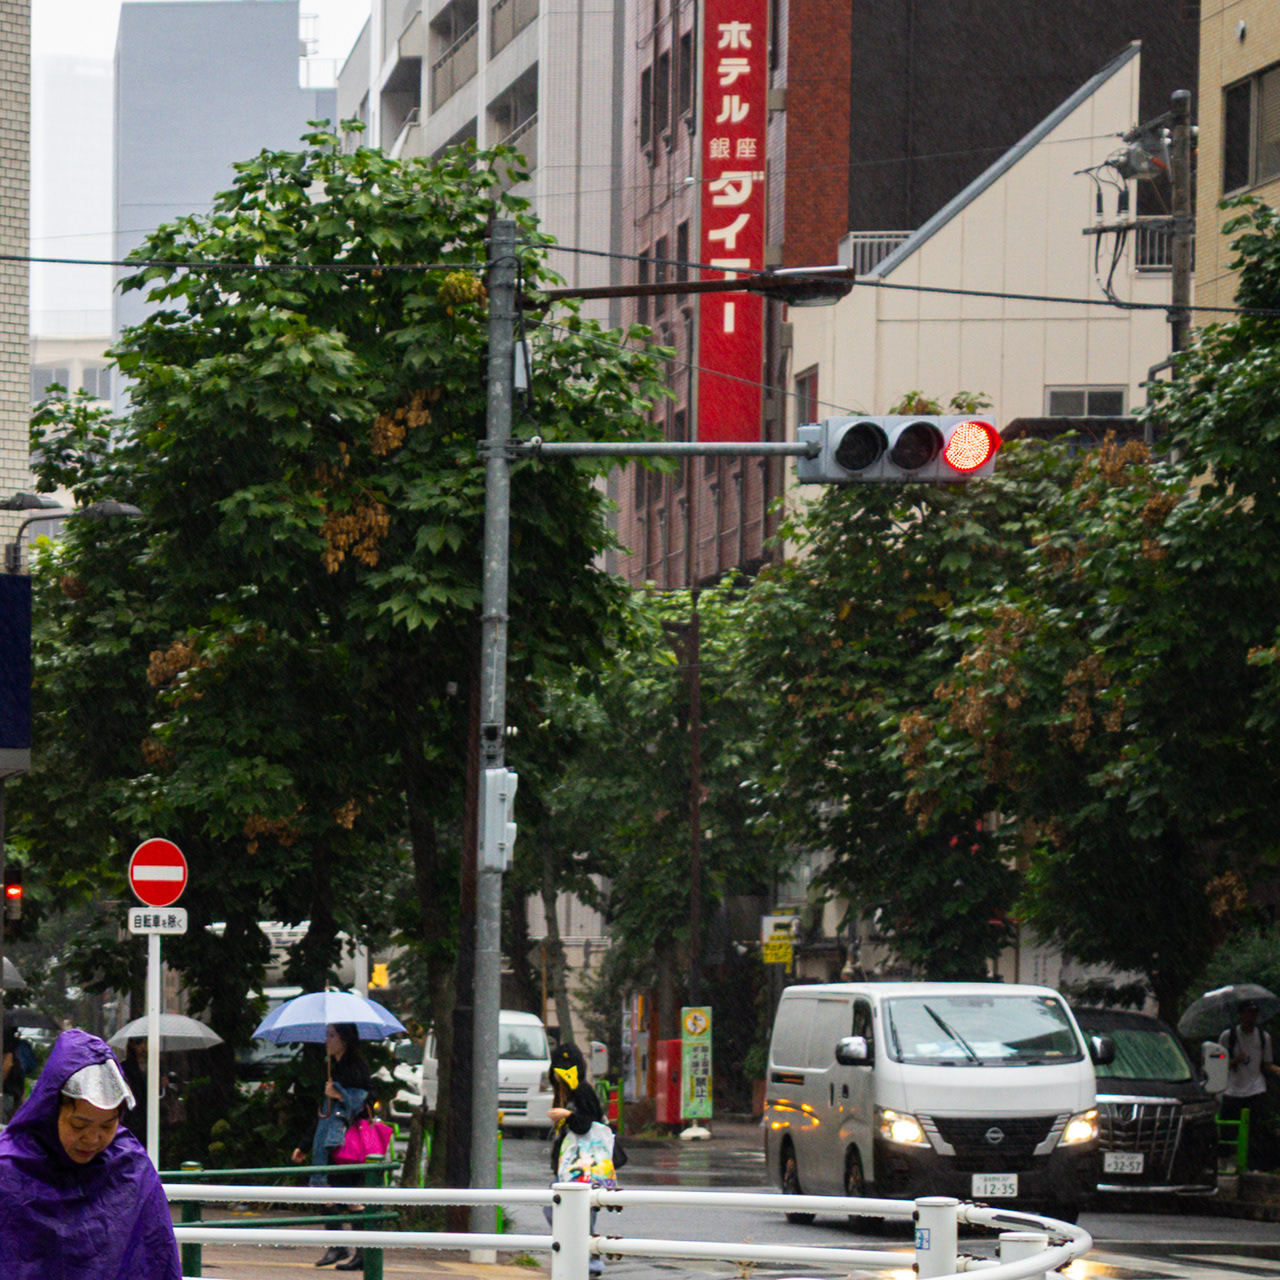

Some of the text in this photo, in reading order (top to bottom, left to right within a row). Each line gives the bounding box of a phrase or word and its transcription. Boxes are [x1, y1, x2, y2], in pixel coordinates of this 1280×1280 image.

[716, 20, 753, 124] ホテル
[709, 137, 757, 159] 銀座
[134, 914, 182, 928] 自転車を除く
[1112, 1160, 1141, 1171] 32-57
[983, 1183, 1015, 1195] 12-35
